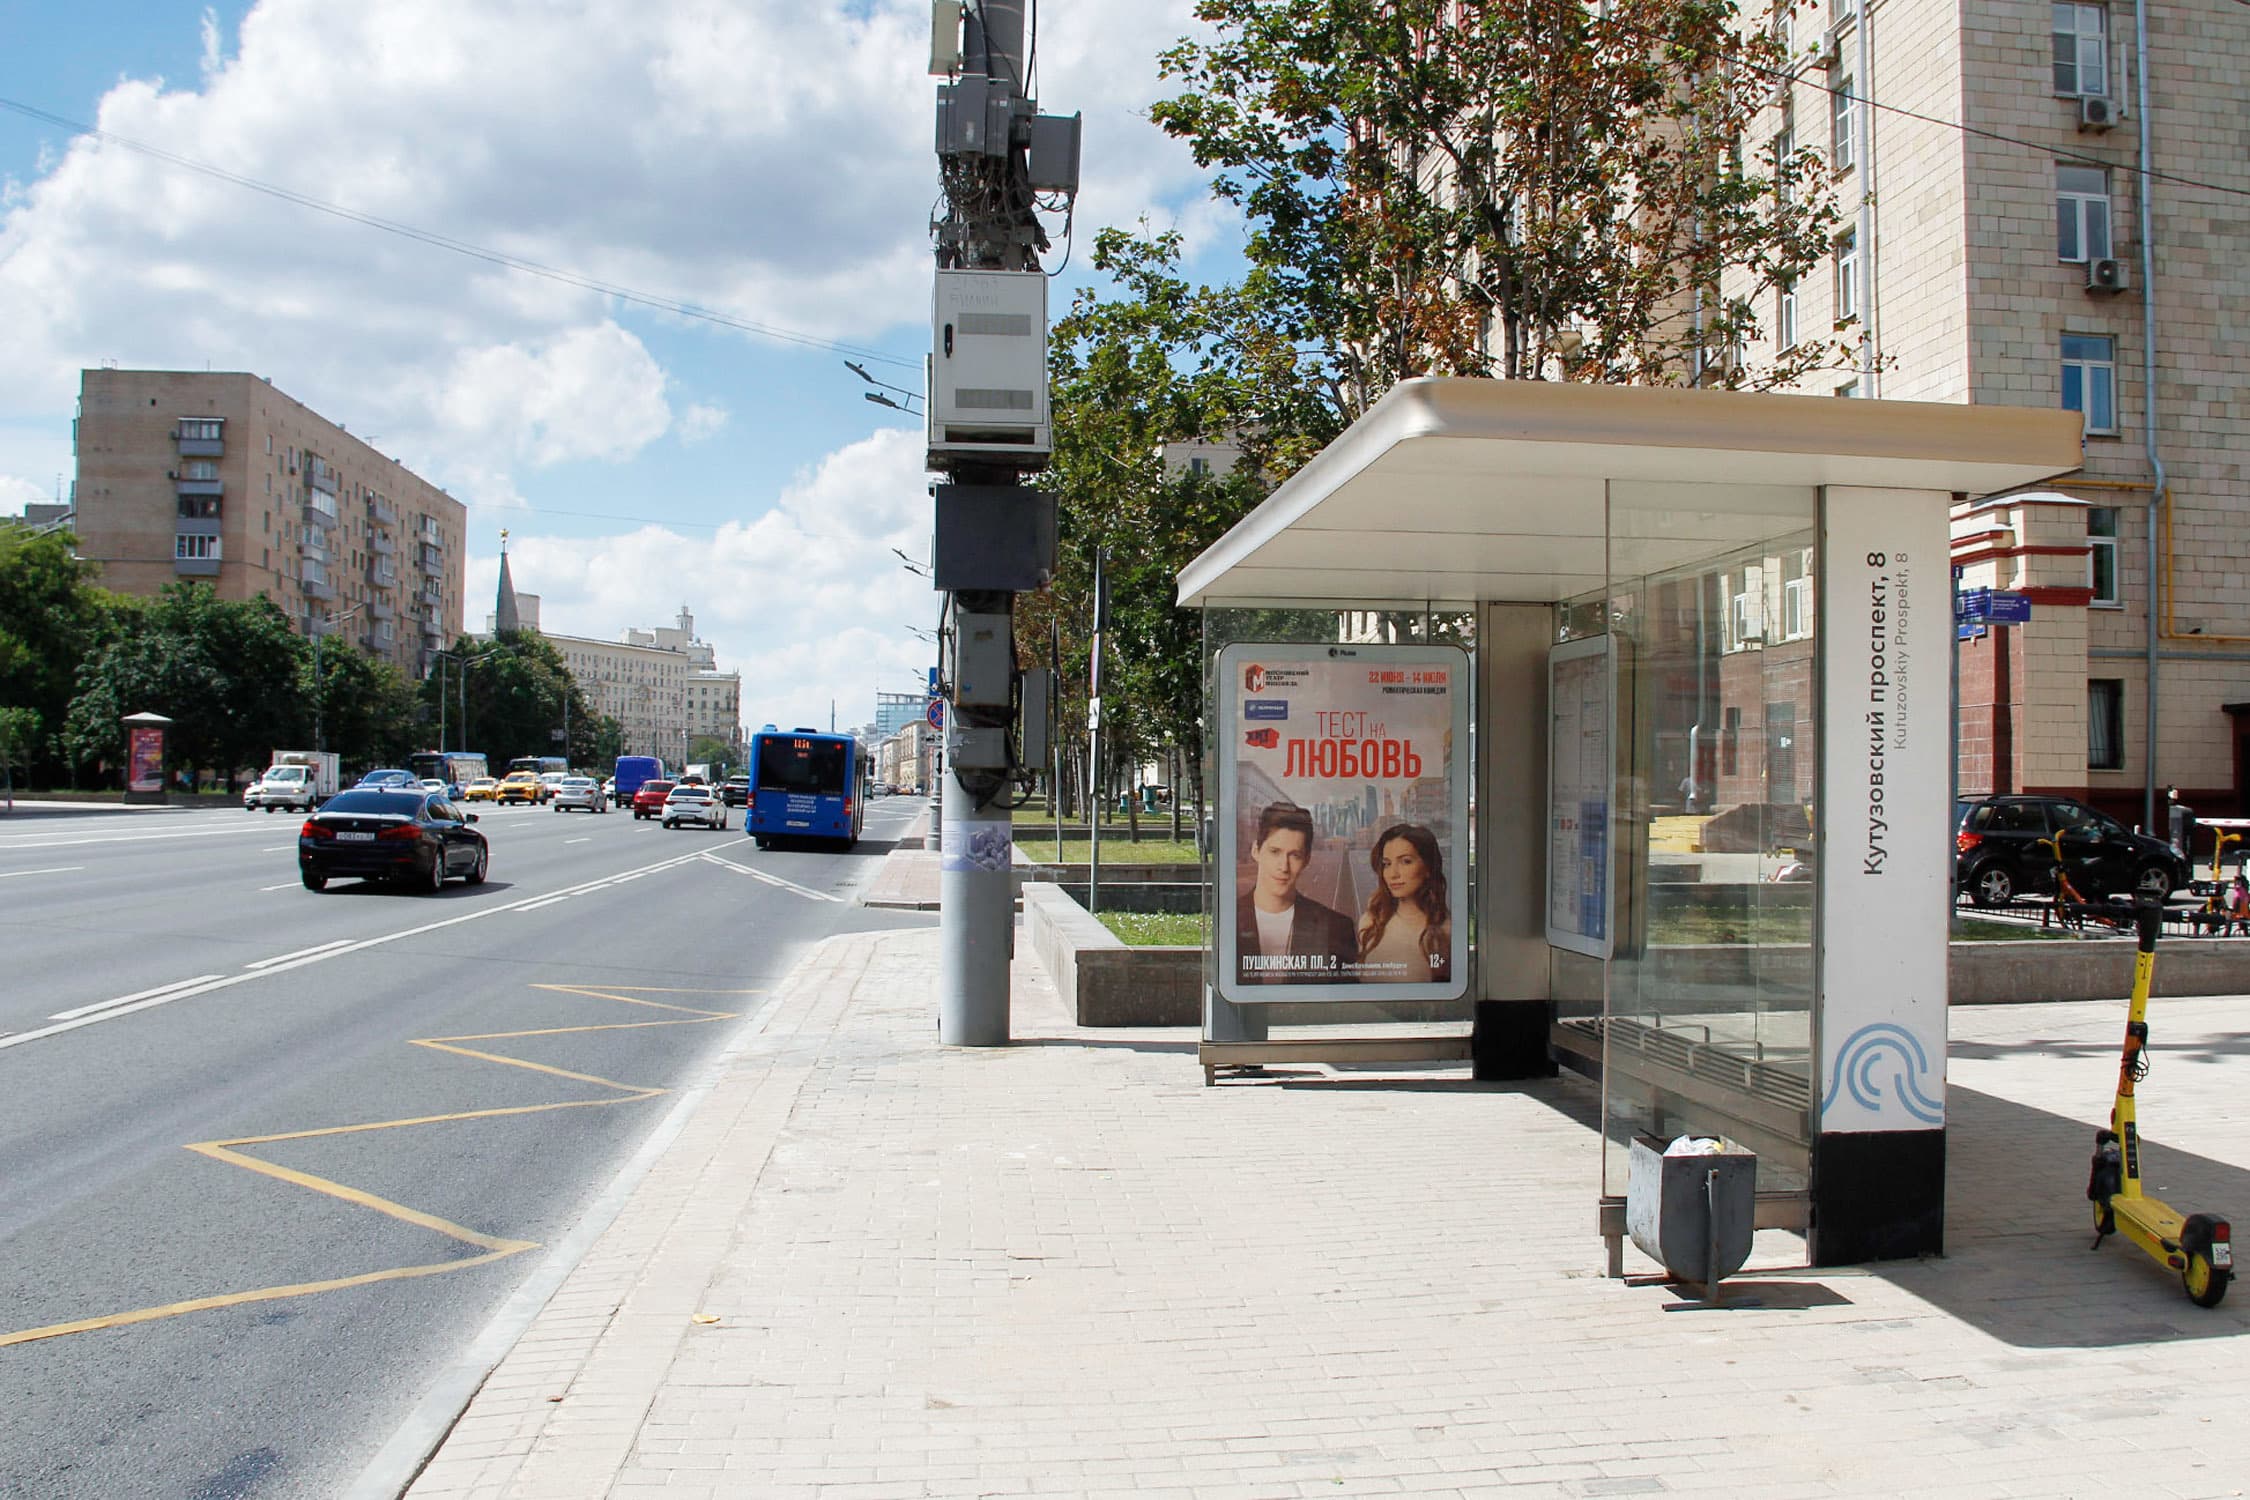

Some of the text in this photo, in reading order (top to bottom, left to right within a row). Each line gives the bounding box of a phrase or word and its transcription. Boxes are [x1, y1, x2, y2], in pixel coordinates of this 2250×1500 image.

[1894, 552, 1912, 750] Kutuzovskiy Prospekt, 8
[1368, 671, 1379, 683] 22
[1381, 671, 1404, 683] ИЮНЯ
[1423, 671, 1447, 684] ИЮЛЯ
[1316, 711, 1387, 738] ТЕСТ НА
[1864, 551, 1890, 875] Кутузовский проспект, 8
[1283, 738, 1422, 778] ЛЮБОВЬ
[1242, 955, 1307, 970] ПУШКИНСКАЯ
[1330, 955, 1337, 969] 2
[1430, 953, 1446, 968] 12+
